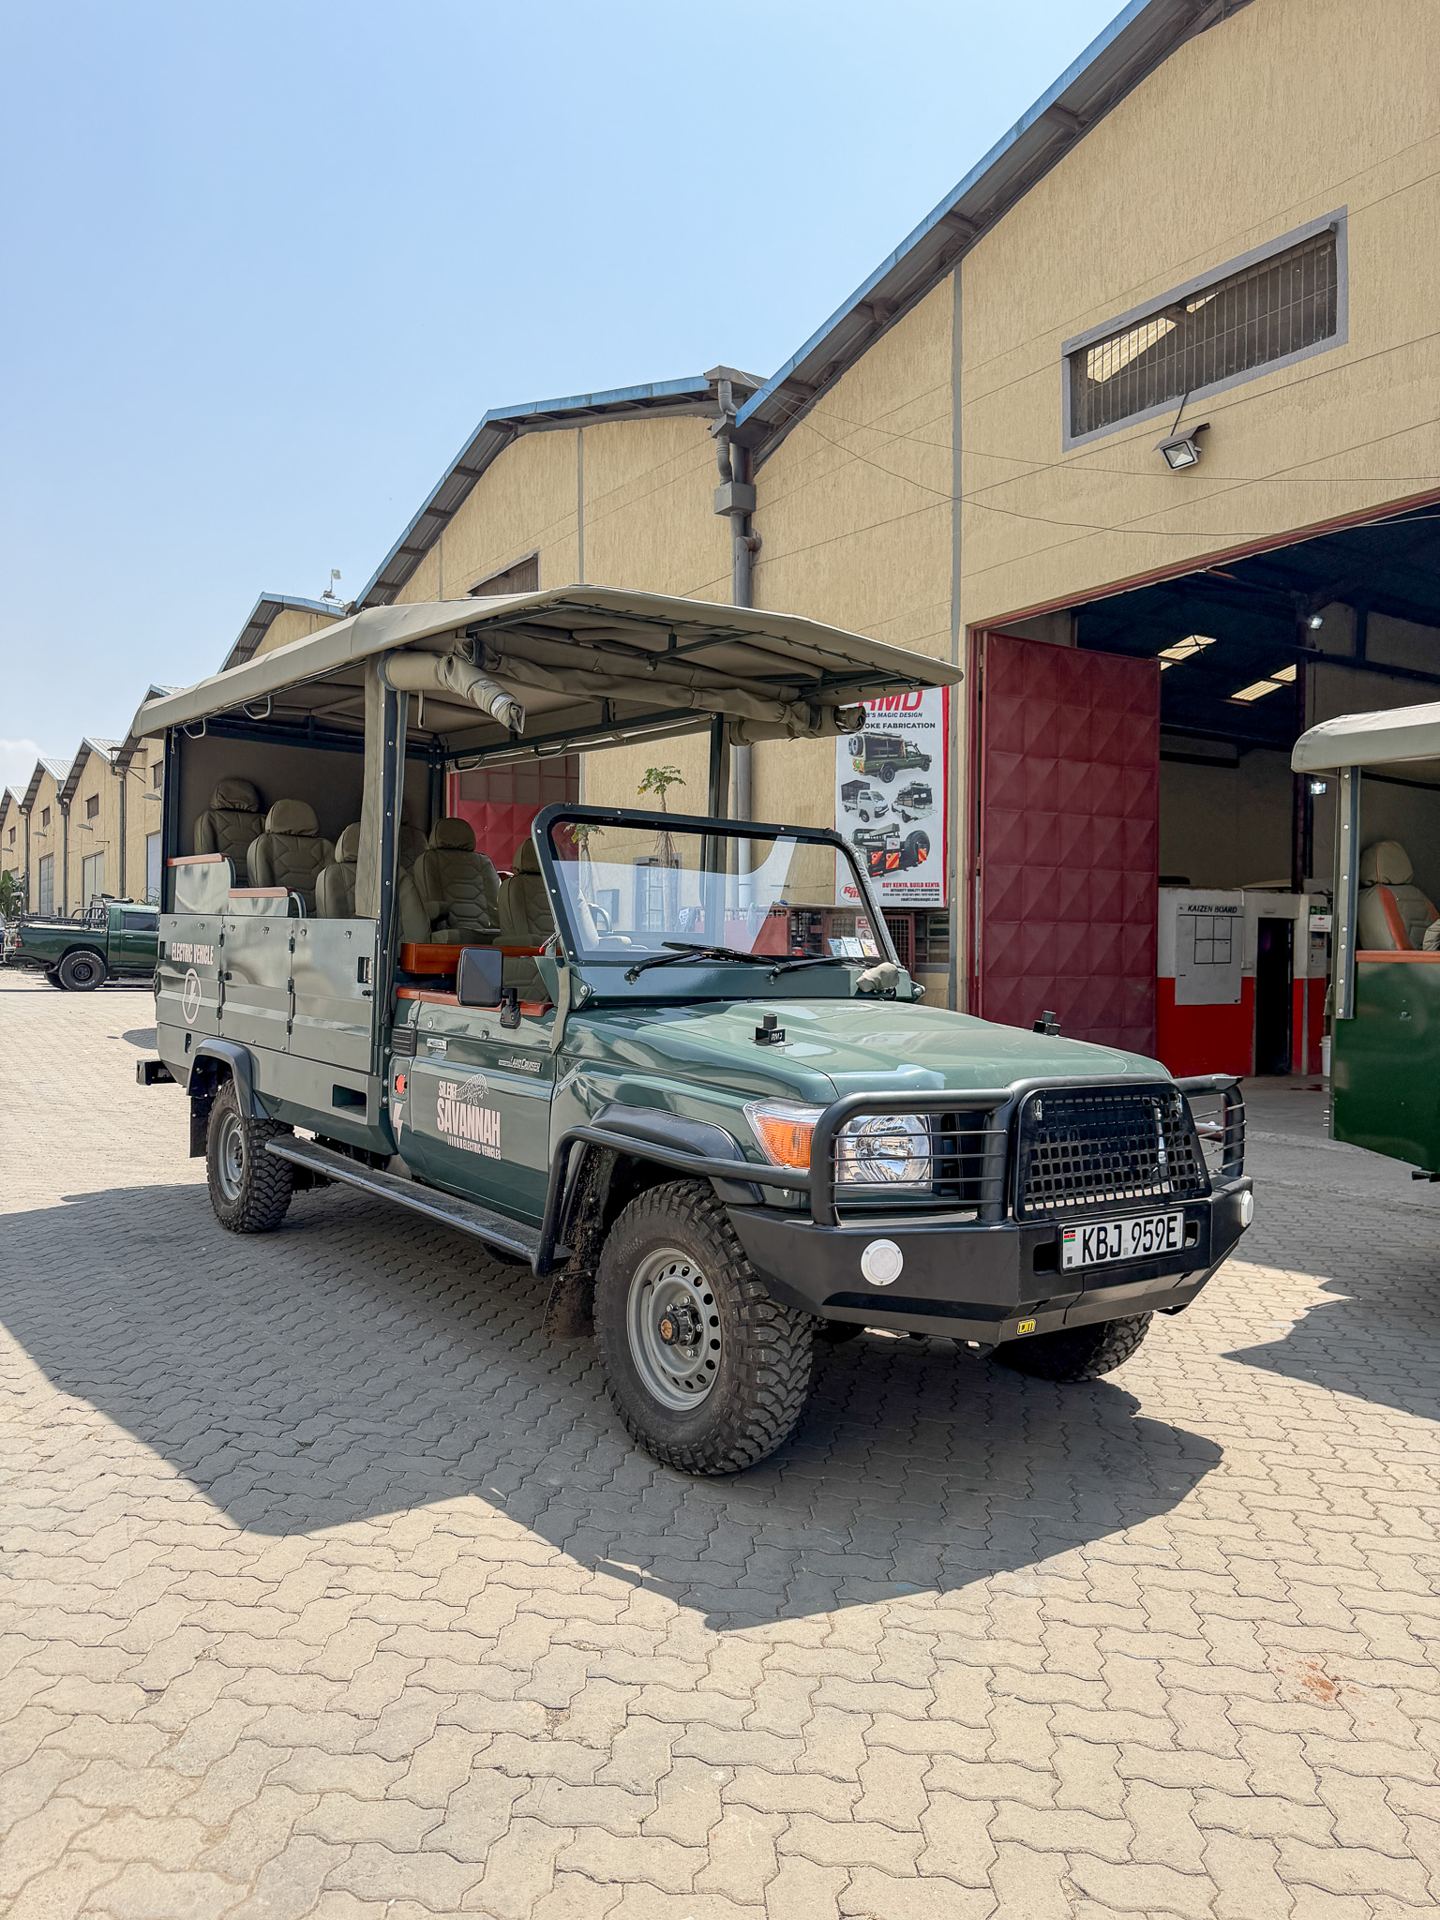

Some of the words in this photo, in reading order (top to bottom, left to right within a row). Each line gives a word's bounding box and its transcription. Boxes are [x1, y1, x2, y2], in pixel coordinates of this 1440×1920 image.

[1214, 905, 1238, 913] BOARD
[172, 942, 193, 963] ELECTRIC
[193, 943, 214, 965] VEHICLE
[437, 1098, 501, 1148] SAVANNAH
[1082, 1224, 1122, 1263] KBJ
[1131, 1215, 1178, 1255] 959E
